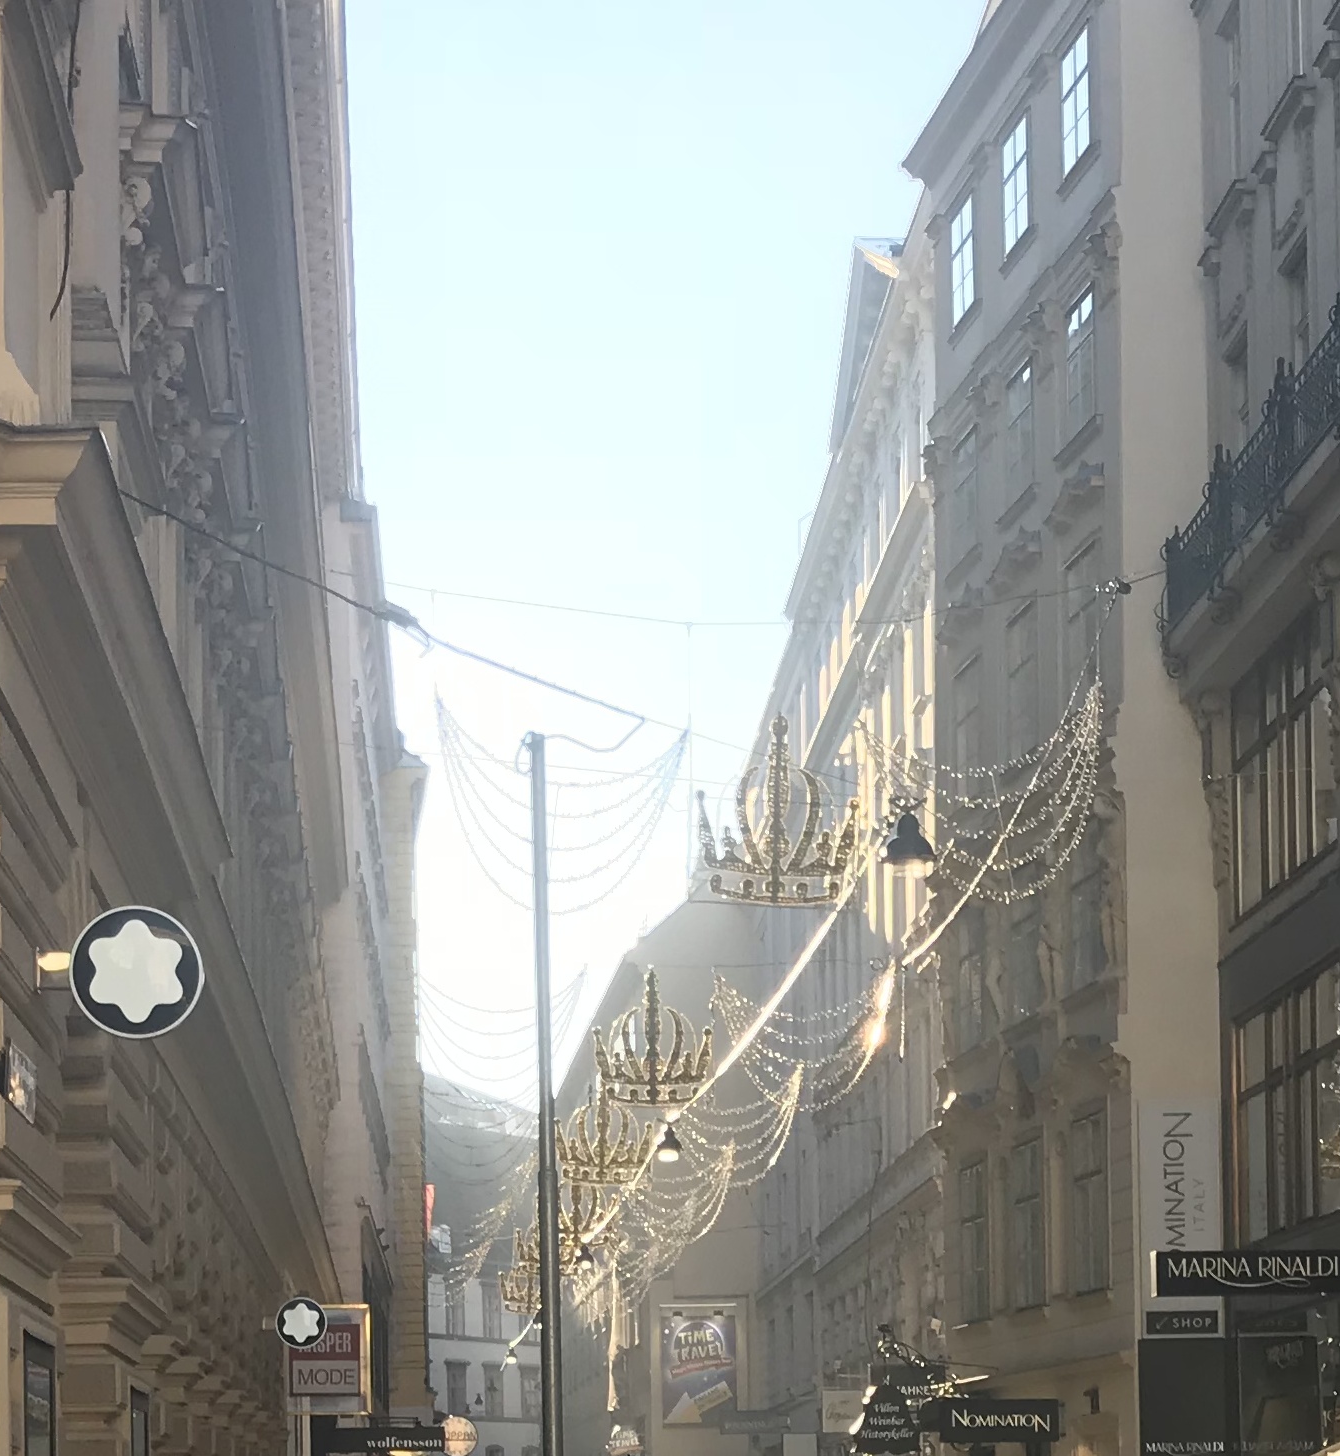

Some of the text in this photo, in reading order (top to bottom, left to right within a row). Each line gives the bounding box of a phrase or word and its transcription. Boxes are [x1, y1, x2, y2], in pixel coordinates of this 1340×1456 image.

[1192, 1177, 1205, 1232] ITALY
[1167, 1255, 1340, 1281] MARINA RINALDI
[1172, 1316, 1212, 1329] SHOP
[672, 1340, 725, 1365] TRAVEL
[298, 1368, 356, 1386] MODE
[951, 1408, 1051, 1434] NOMINATION
[366, 1436, 443, 1449] wolfensson
